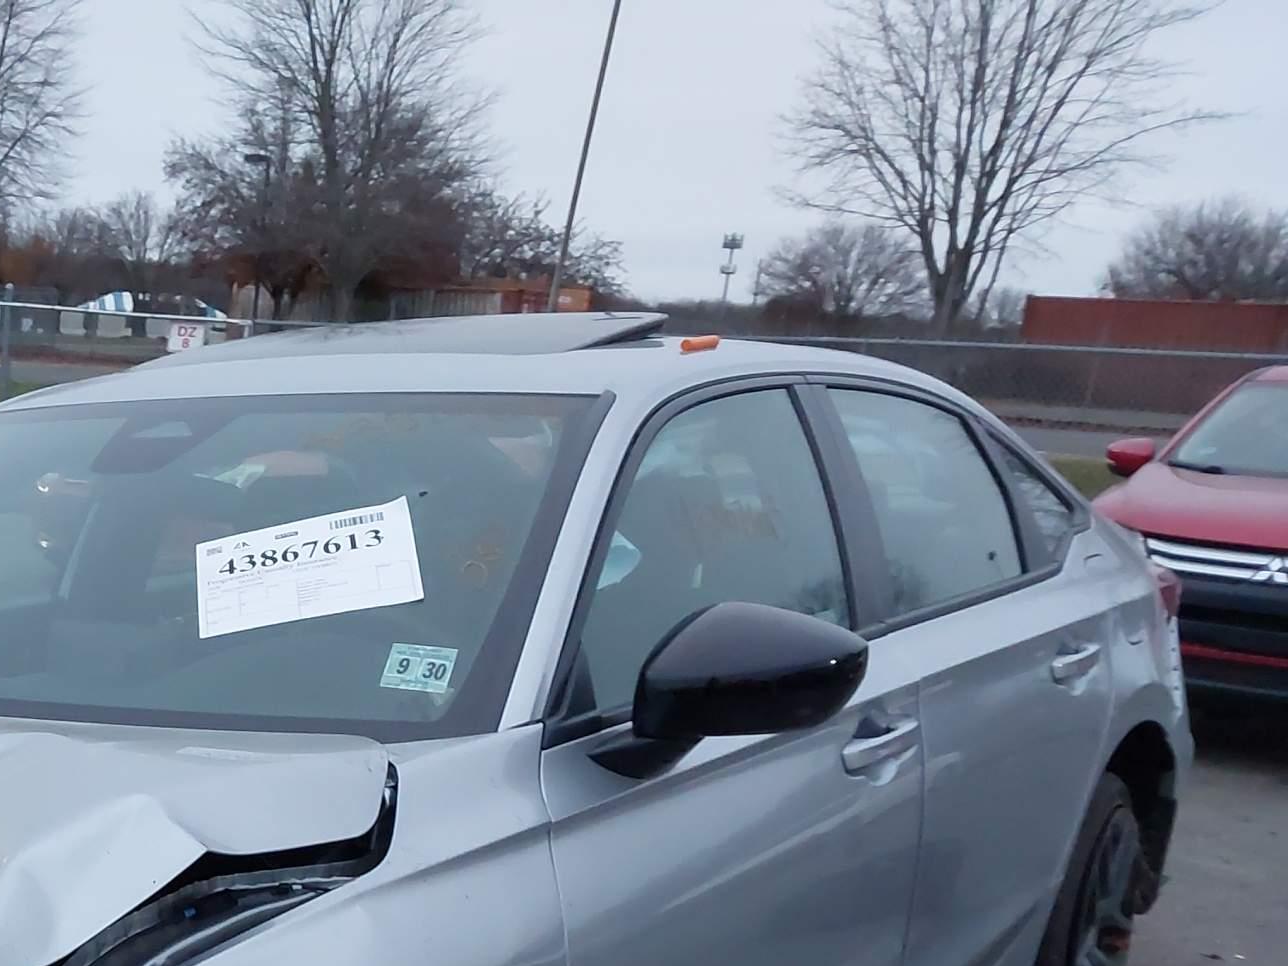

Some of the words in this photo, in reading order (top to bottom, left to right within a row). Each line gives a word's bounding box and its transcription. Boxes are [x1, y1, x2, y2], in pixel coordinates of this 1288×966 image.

[177, 326, 197, 337] DZ
[218, 529, 384, 575] 43867613
[396, 658, 410, 674] 9
[422, 662, 447, 680] 30
